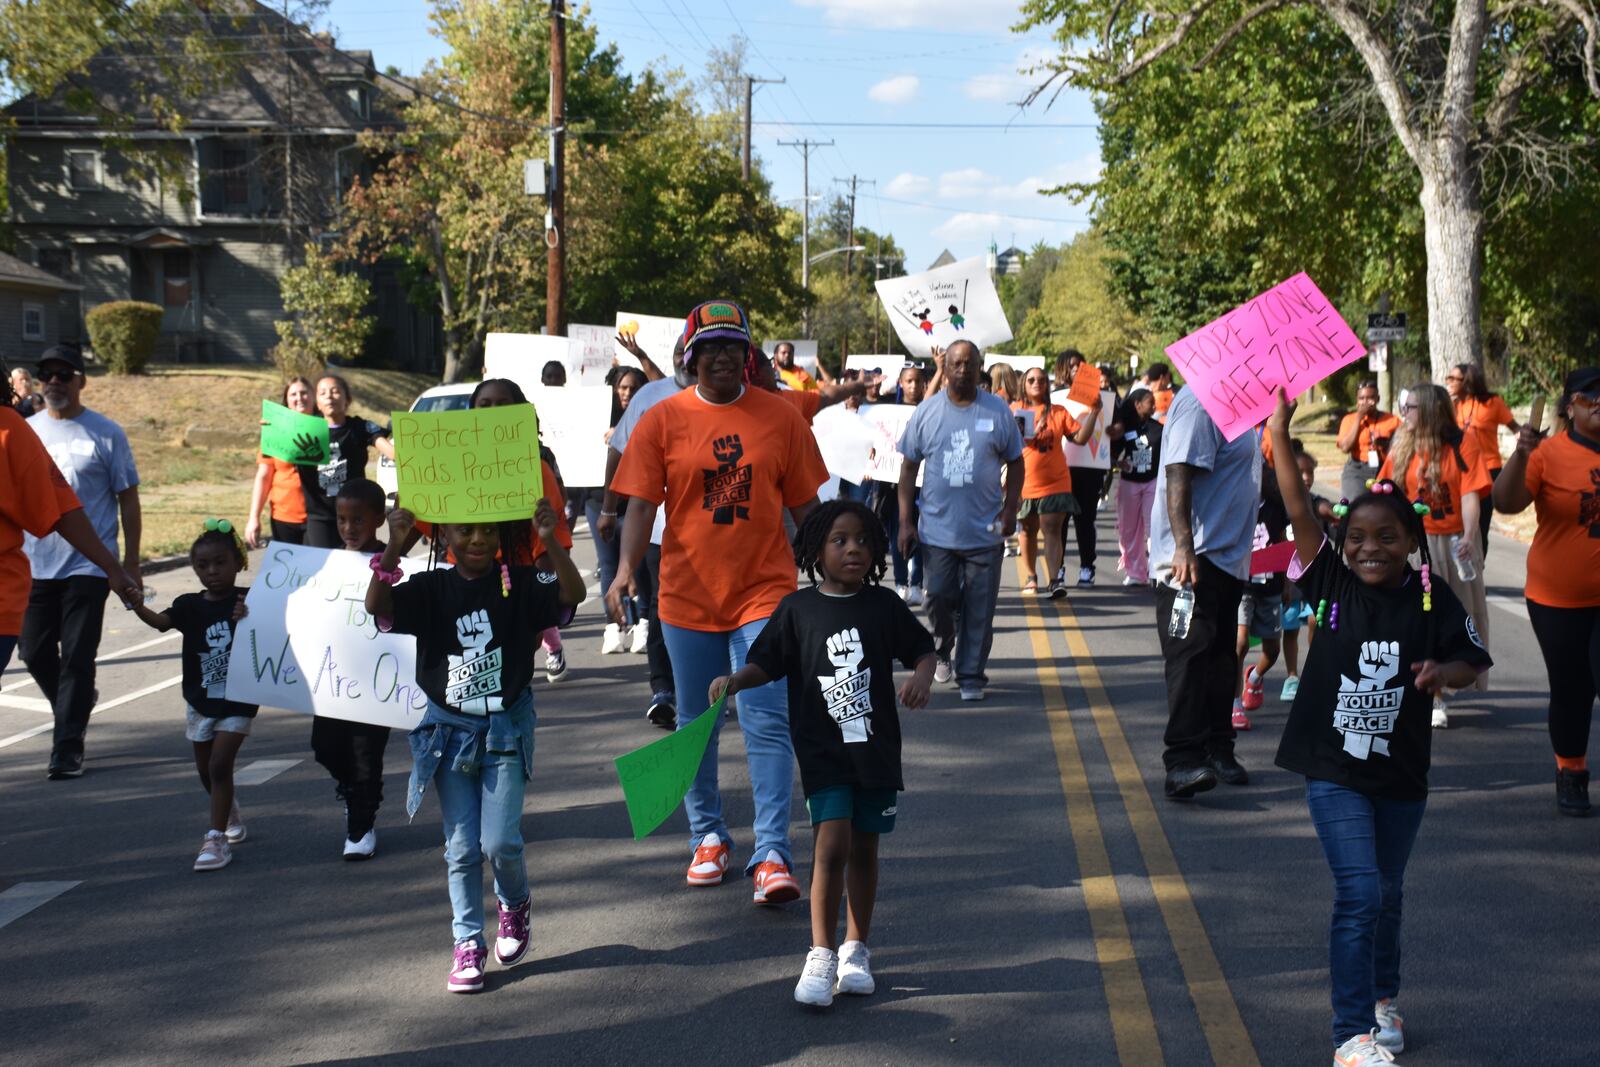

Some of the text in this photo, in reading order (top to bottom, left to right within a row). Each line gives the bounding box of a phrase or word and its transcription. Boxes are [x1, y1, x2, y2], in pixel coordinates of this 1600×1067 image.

[1174, 276, 1327, 376] HOPE ZONE
[1210, 316, 1355, 427] SAFE ZONE
[400, 416, 484, 450] Protect
[493, 420, 524, 442] our
[462, 443, 536, 481] Protect
[710, 469, 748, 490] YOUTH
[412, 493, 456, 516] our
[710, 487, 745, 506] PEACE
[250, 628, 428, 716] We Are One
[452, 653, 498, 682] YOUTH
[453, 676, 496, 701] PEACE
[826, 673, 868, 704] YOUTH
[1342, 692, 1396, 709] YOUTH
[832, 695, 869, 720] PEACE
[1340, 715, 1388, 730] PEACE
